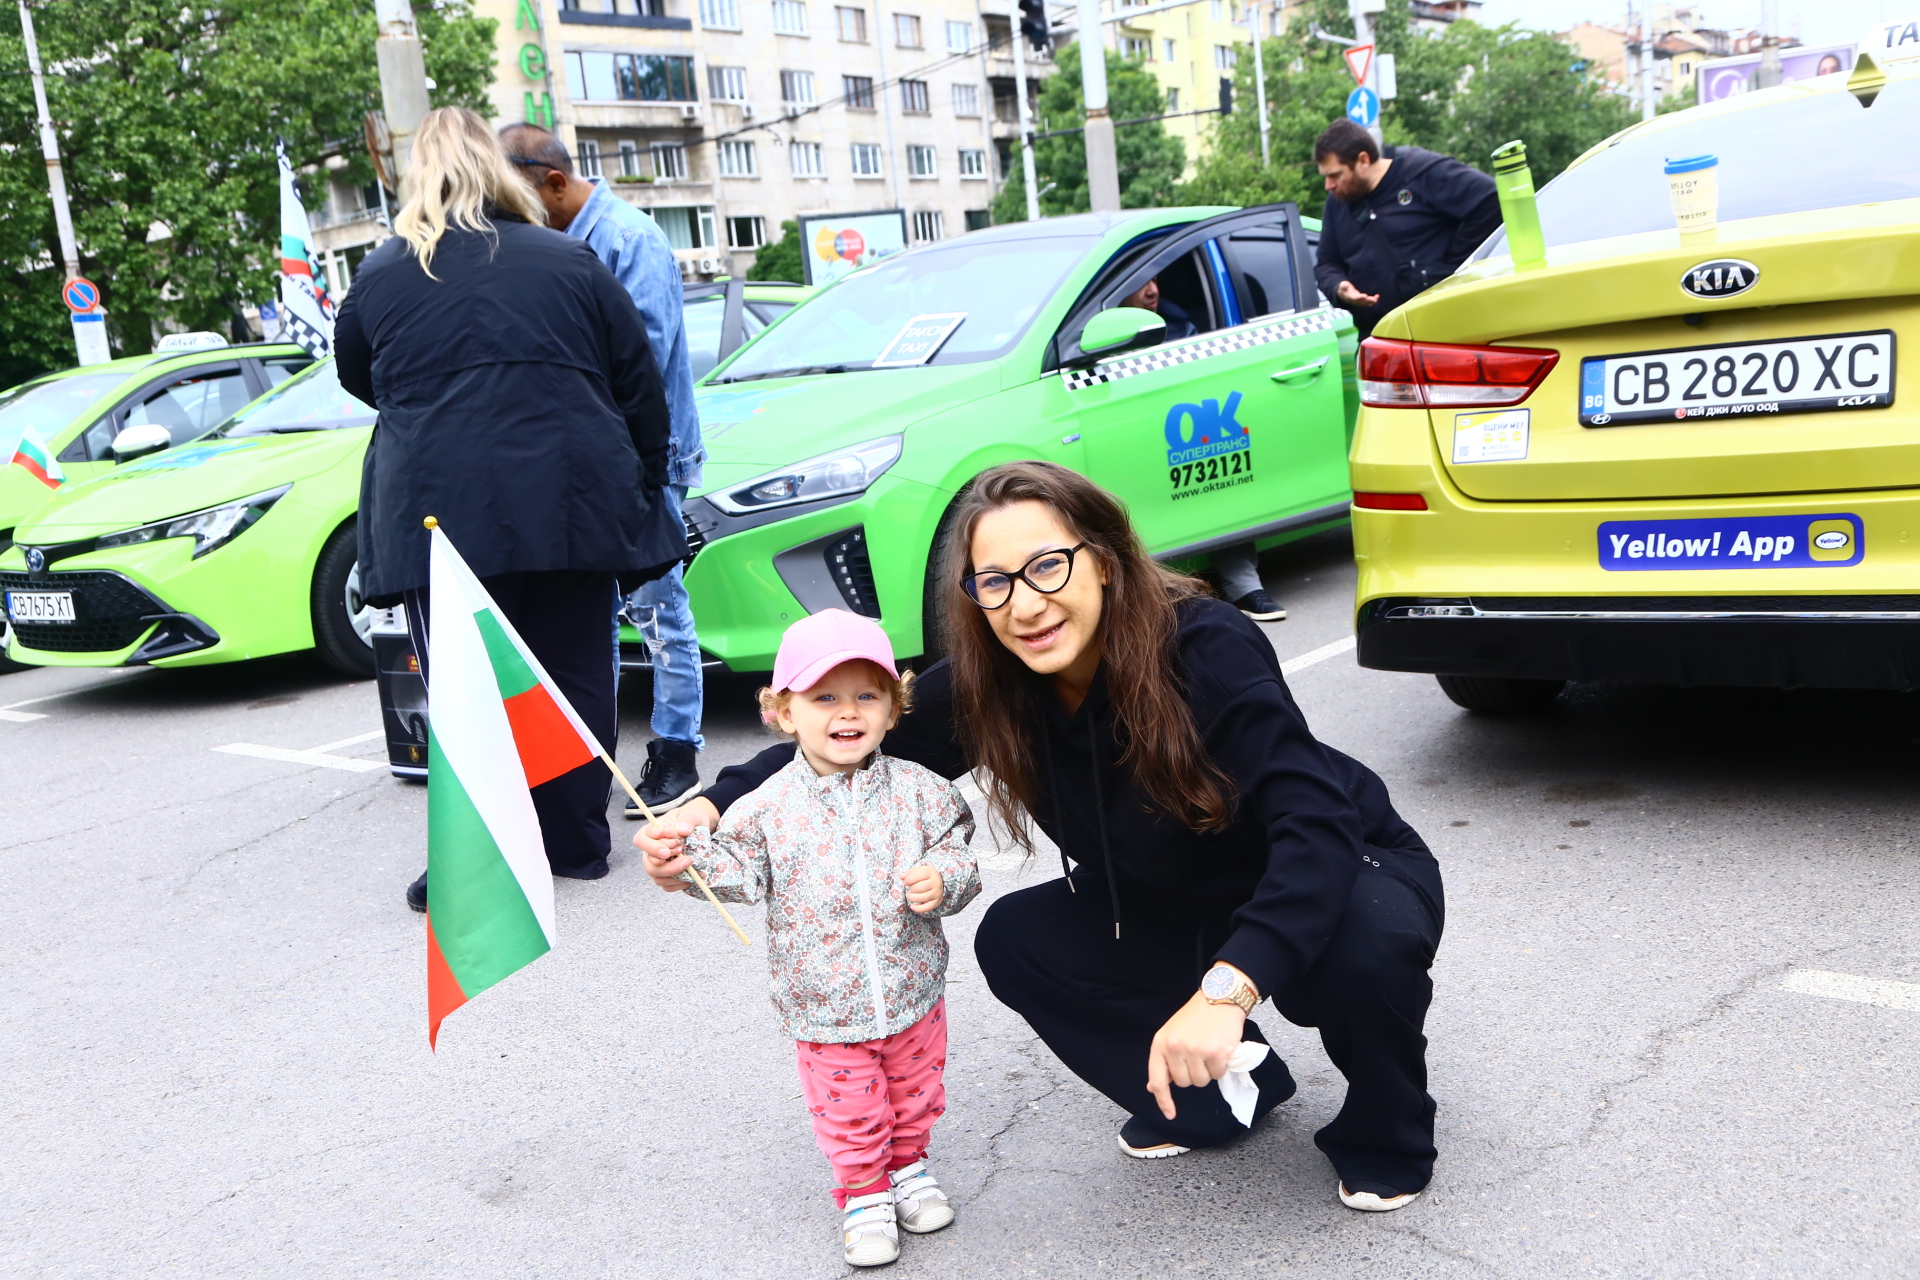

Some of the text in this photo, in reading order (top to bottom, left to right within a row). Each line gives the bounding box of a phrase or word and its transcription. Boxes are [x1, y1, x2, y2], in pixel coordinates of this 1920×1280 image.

[1692, 266, 1747, 292] KIA
[897, 341, 930, 354] TAXI
[1613, 343, 1880, 406] CB 2820 XC
[1585, 395, 1604, 408] BG
[1687, 406, 1705, 417] КЕЙ
[1706, 405, 1729, 417] ДЖИ
[1730, 403, 1755, 414] АУТО
[1756, 402, 1779, 413] ООД
[1837, 394, 1877, 407] KIA
[1483, 423, 1508, 431] ОЦЕНИ
[1170, 436, 1248, 464] СУПЕРТРАНС
[1170, 450, 1251, 489] 9732121
[1171, 474, 1254, 501] www.oktaxi.net
[1609, 530, 1795, 562] Yellow! App
[12, 596, 71, 617] CB 7675 XT
